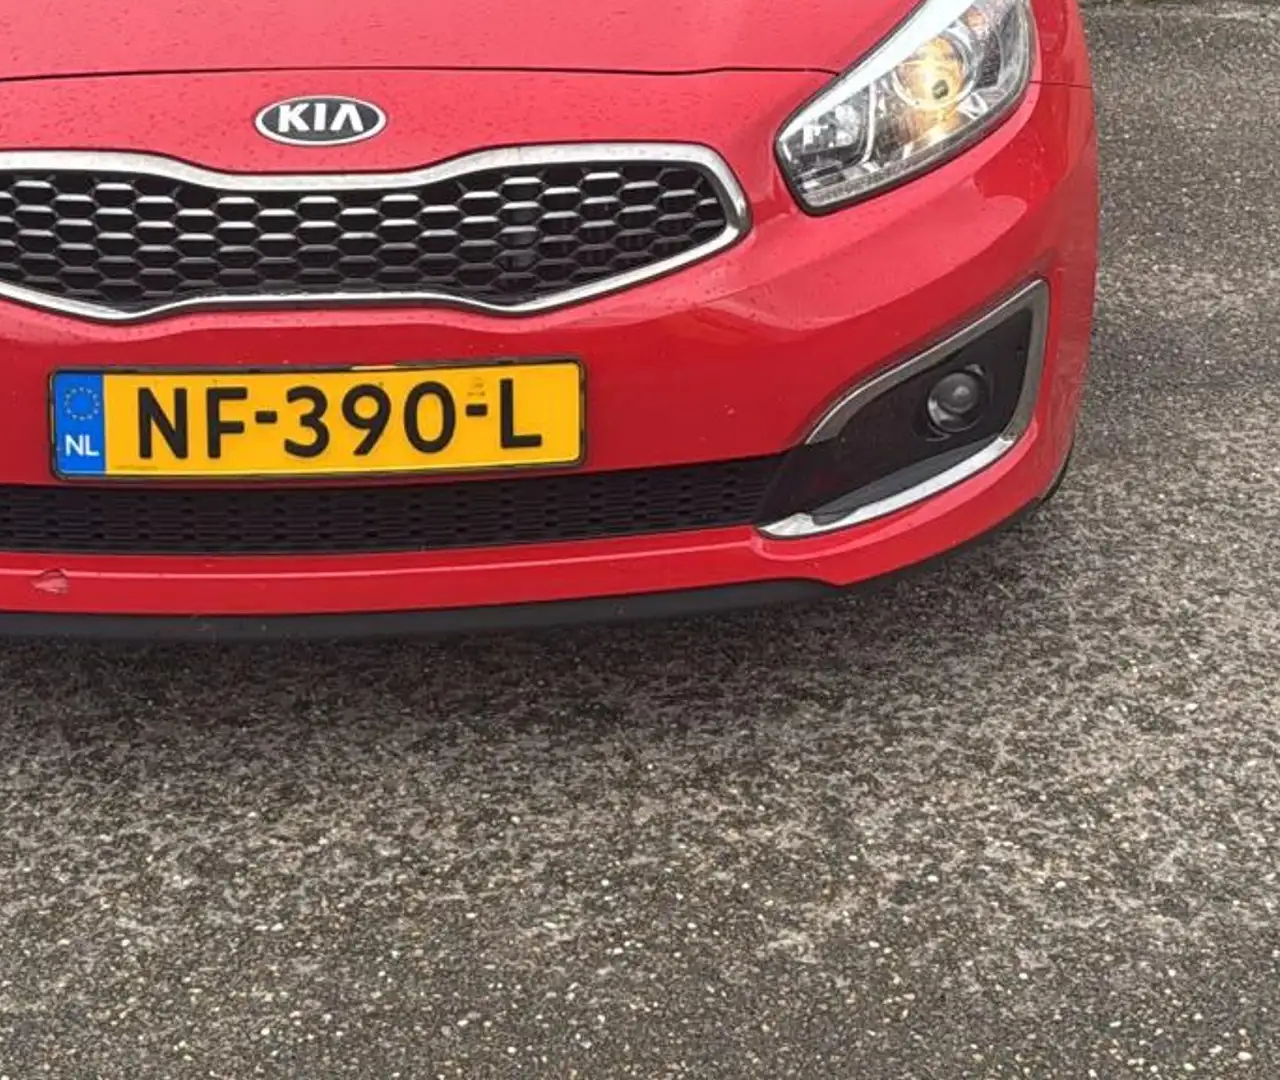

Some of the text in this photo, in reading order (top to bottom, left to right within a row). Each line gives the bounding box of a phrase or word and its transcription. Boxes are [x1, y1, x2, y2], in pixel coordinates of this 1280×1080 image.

[277, 102, 365, 133] KIA
[136, 377, 542, 459] NF-390-L
[64, 434, 100, 458] NL
